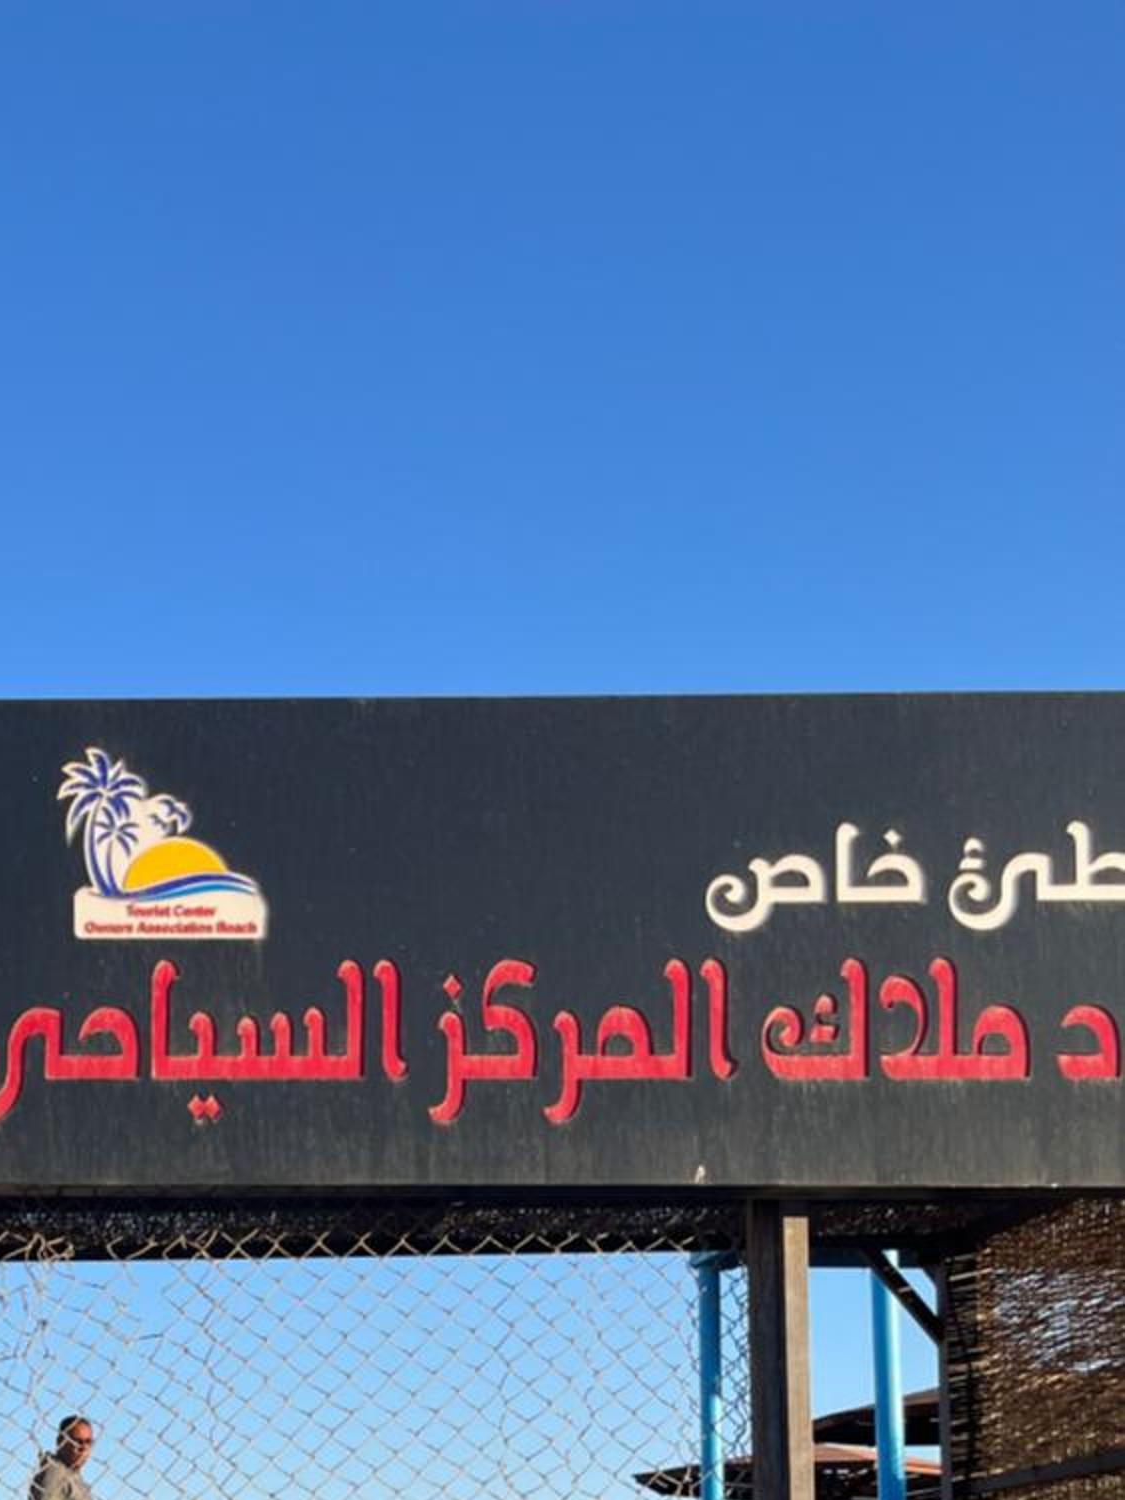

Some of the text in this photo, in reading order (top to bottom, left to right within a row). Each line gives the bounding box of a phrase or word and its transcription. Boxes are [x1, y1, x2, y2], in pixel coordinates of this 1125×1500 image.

[84, 921, 258, 934] Owners Association Beach
[126, 904, 217, 917] Tourist Center
[704, 821, 926, 932] خاص
[427, 957, 738, 1124] المركز
[761, 957, 1030, 1081] ملاك
